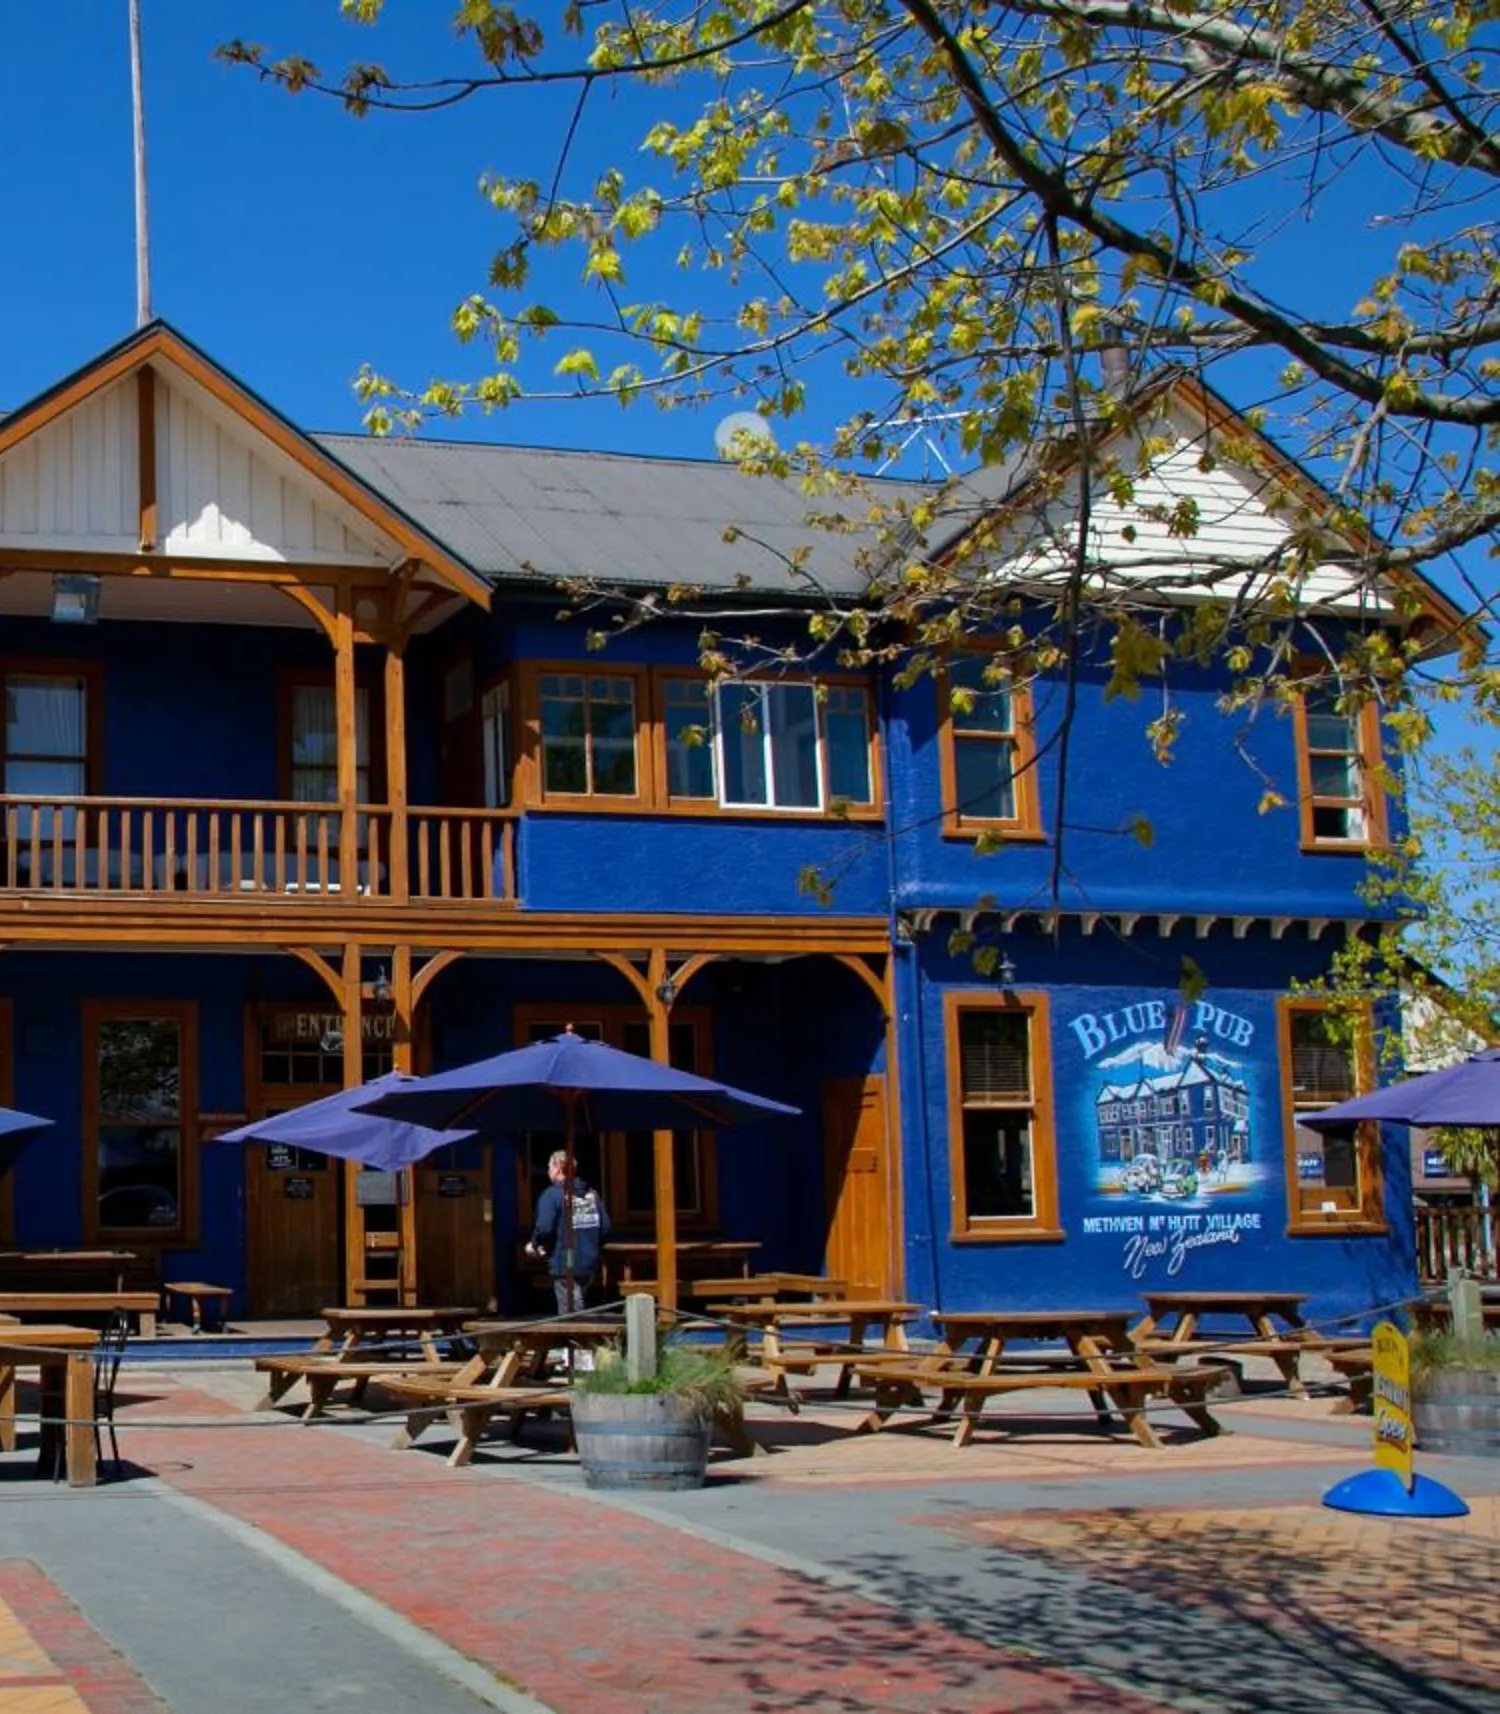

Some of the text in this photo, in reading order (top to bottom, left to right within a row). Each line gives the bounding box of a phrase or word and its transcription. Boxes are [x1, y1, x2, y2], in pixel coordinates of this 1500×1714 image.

[1067, 1000, 1255, 1060] BLUE PUB
[1083, 1215, 1144, 1233] METHVEN
[1167, 1214, 1201, 1232] HUTT
[1205, 1213, 1262, 1230] VILLAGE
[1123, 1227, 1240, 1279] New Zealand
